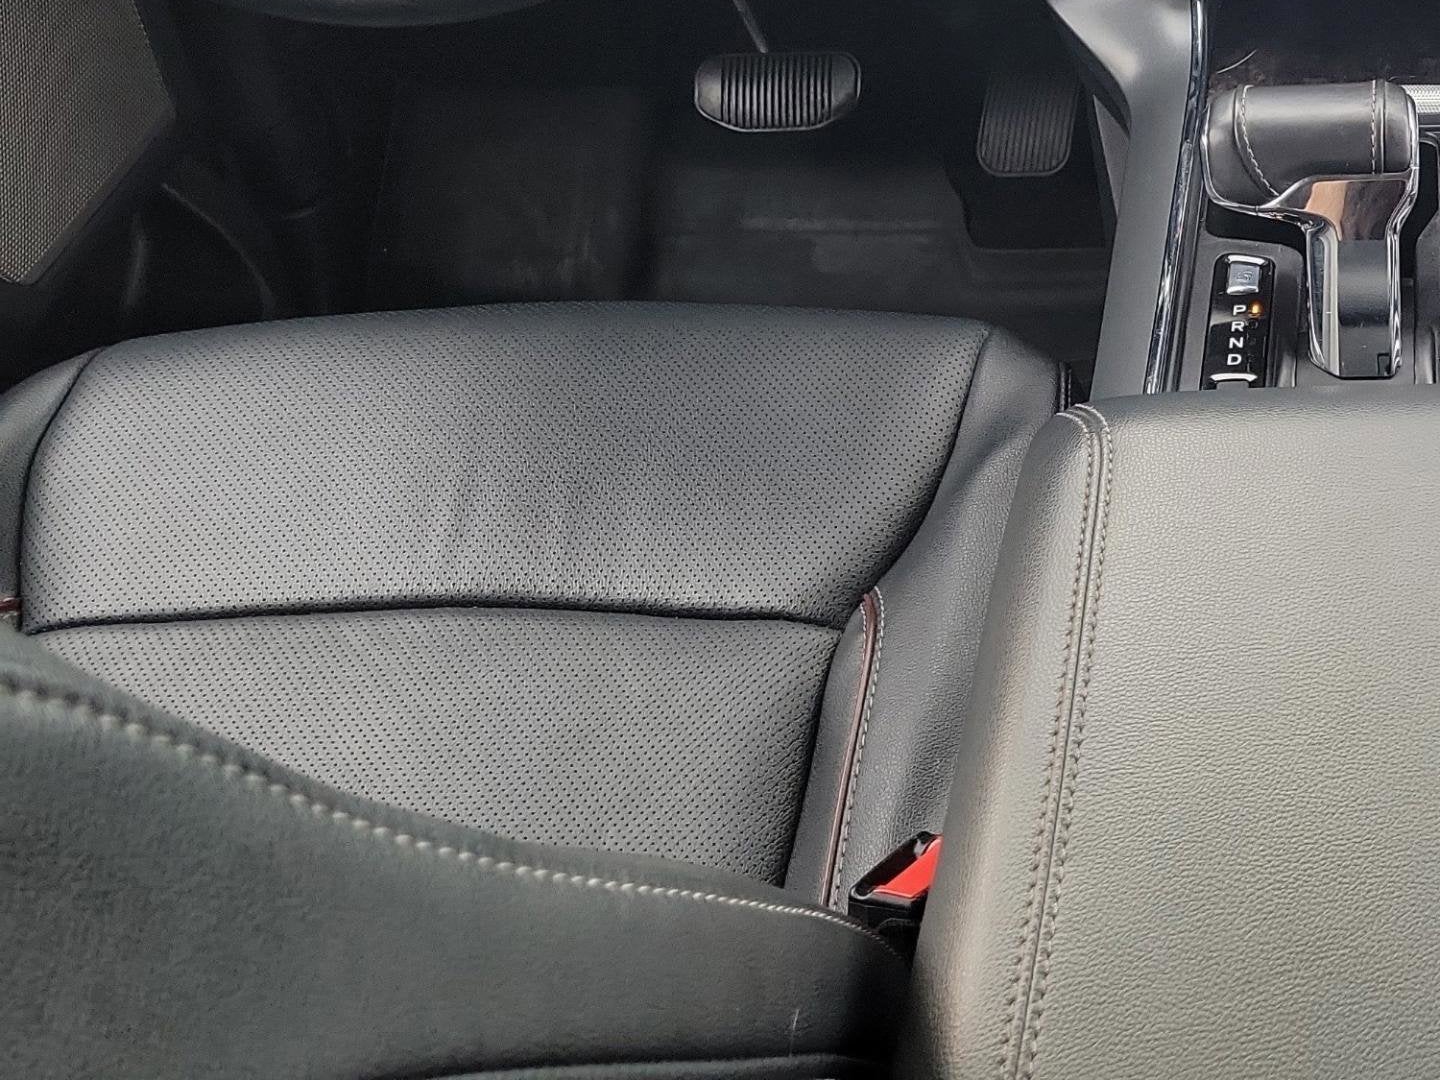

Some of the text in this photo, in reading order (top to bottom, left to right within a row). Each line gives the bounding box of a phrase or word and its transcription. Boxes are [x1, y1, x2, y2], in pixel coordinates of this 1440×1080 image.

[1233, 305, 1246, 316] P
[1231, 321, 1245, 332] R
[1229, 337, 1244, 349] N
[1227, 353, 1242, 366] D
